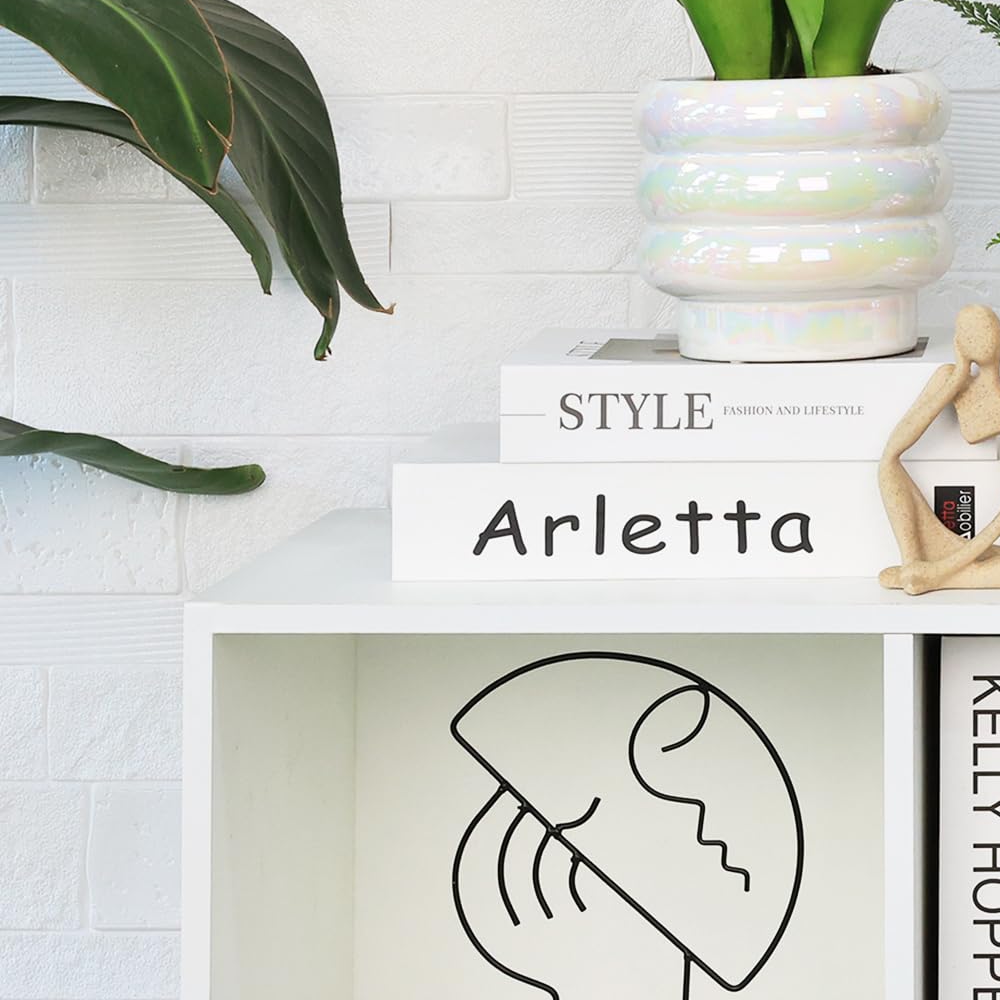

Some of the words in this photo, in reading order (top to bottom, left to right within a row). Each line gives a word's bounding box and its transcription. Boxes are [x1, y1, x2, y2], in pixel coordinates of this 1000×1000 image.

[558, 392, 714, 431] STYLE
[722, 405, 773, 416] FASHION
[776, 405, 801, 416] AND
[804, 405, 865, 416] LIFESTYLE
[472, 494, 815, 557] Arletta
[941, 500, 956, 530] etta
